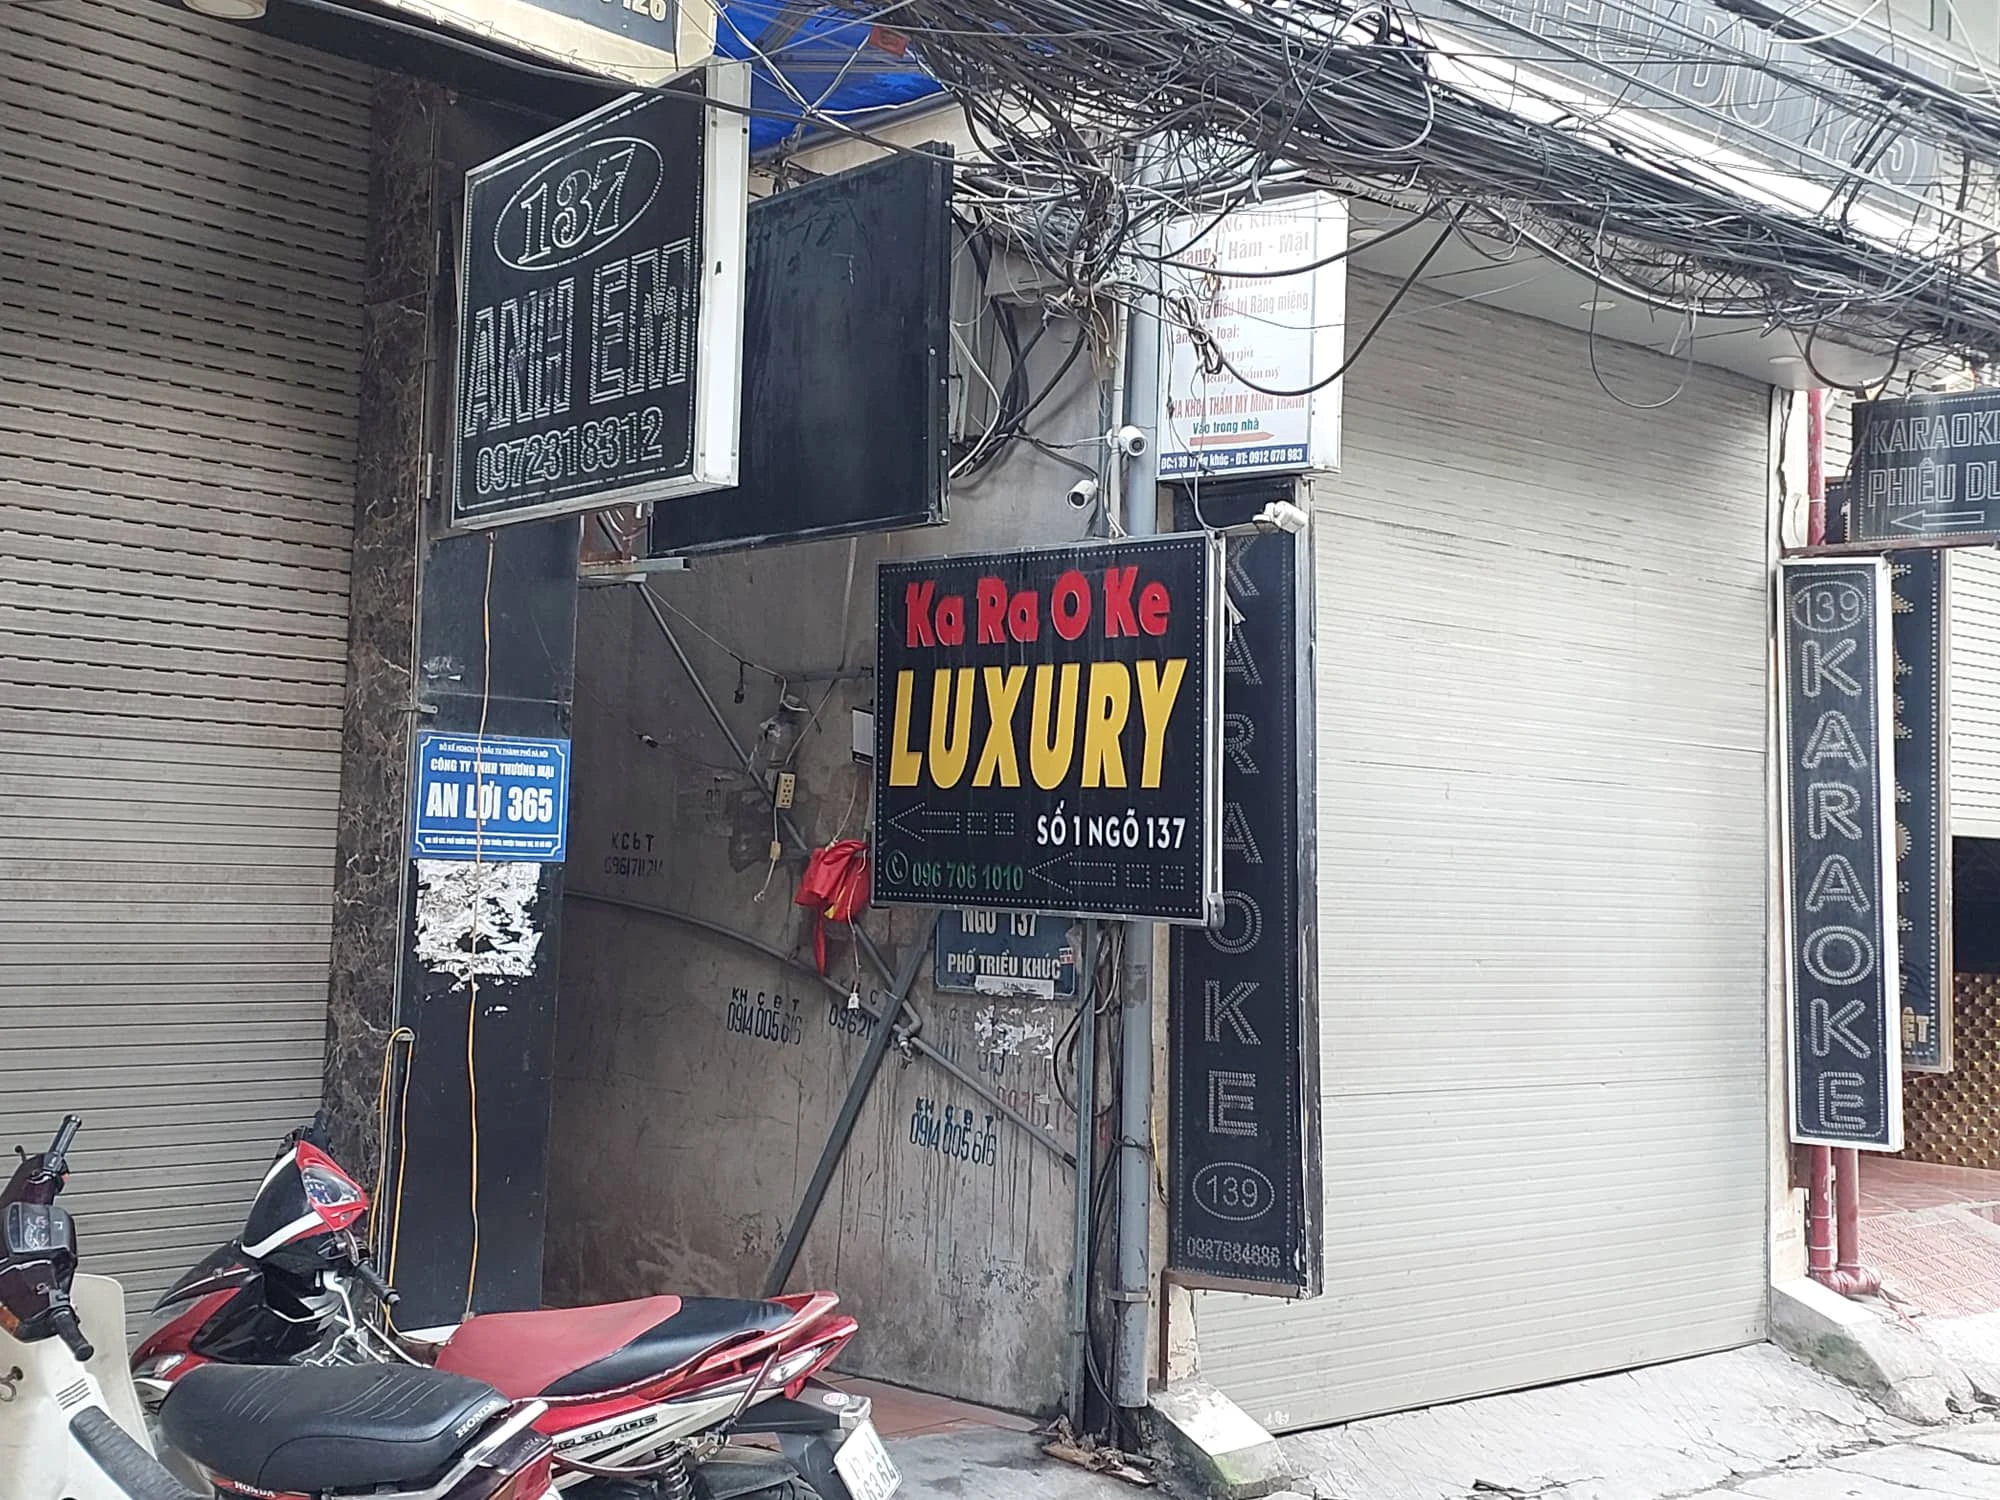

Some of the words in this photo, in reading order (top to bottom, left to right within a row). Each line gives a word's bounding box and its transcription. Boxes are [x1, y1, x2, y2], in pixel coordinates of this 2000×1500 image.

[517, 142, 637, 264] 137
[464, 277, 575, 437] ANH
[590, 237, 691, 404] EM
[1213, 420, 1238, 434] trong
[1241, 417, 1260, 430] nhà
[476, 406, 663, 494] 0972318312
[1867, 457, 1956, 507] PHIÊU
[1798, 590, 1861, 625] 139
[889, 658, 1188, 791] LUXURY
[430, 756, 457, 772] CÔNG
[459, 760, 472, 773] TY
[537, 764, 555, 780] MẠI
[425, 782, 459, 818] AN
[466, 780, 502, 826] LỢI
[507, 786, 553, 823] 365
[1036, 800, 1066, 846] SỐ
[1073, 814, 1081, 847] 1
[1088, 808, 1140, 848] NGÕ
[1147, 815, 1187, 849] 137
[1801, 637, 1876, 1131] KARAOKE
[1010, 911, 1037, 937] 137
[948, 947, 977, 974] PHỐ
[979, 949, 1019, 977] TRIỀU
[1022, 953, 1061, 980] KHÚC
[1206, 1174, 1259, 1209] 139
